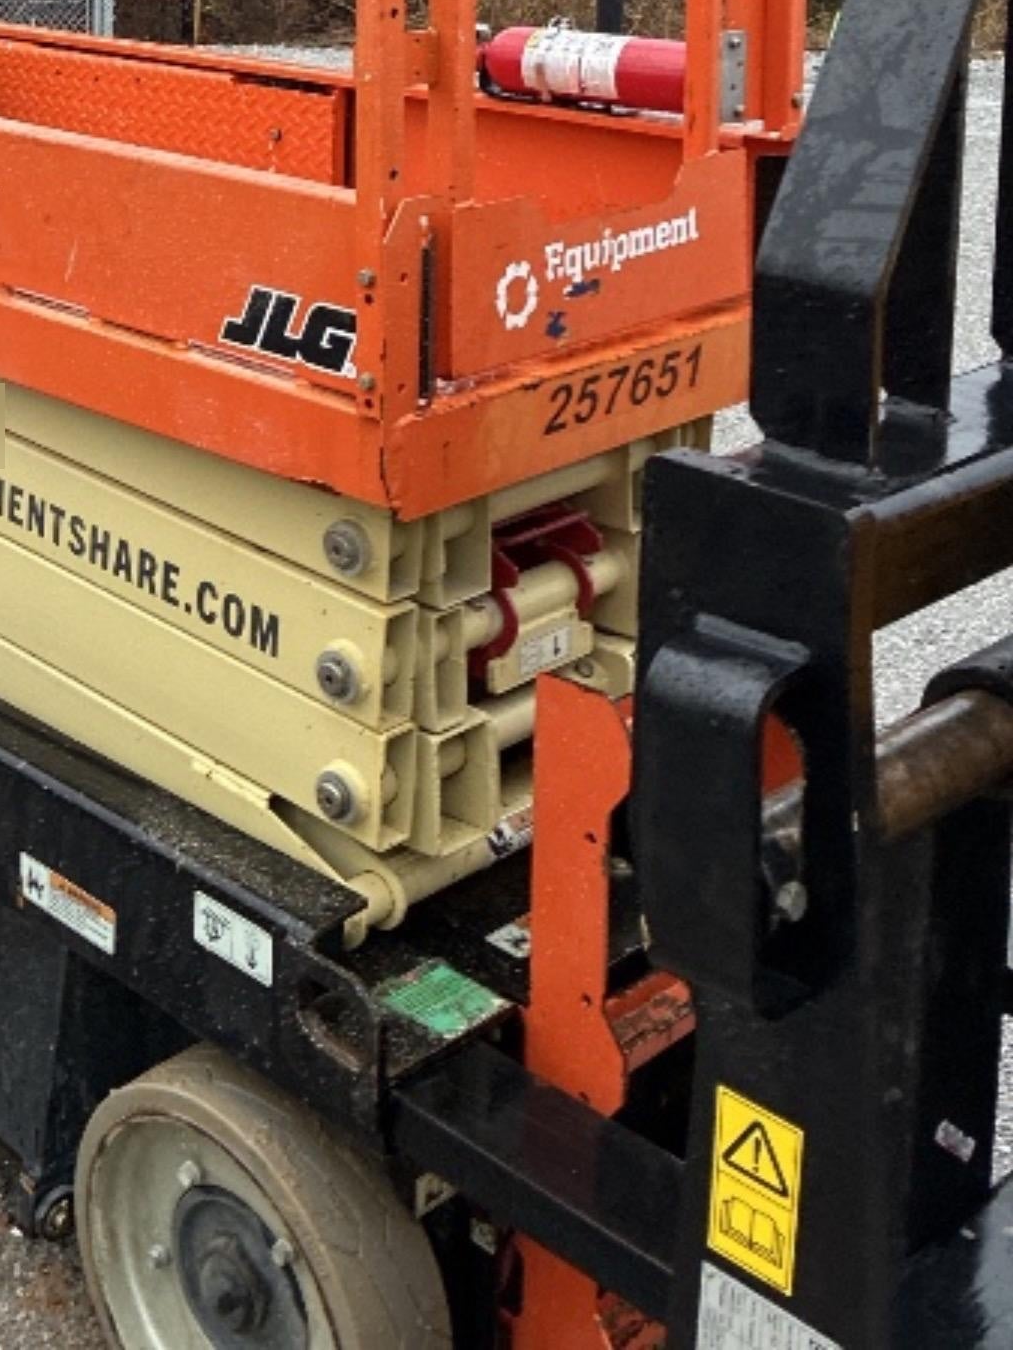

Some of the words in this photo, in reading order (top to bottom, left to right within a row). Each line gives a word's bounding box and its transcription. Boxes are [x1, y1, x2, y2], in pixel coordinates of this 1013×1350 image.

[544, 207, 700, 286] Equipment
[217, 284, 358, 378] JLG
[544, 344, 704, 436] 257651
